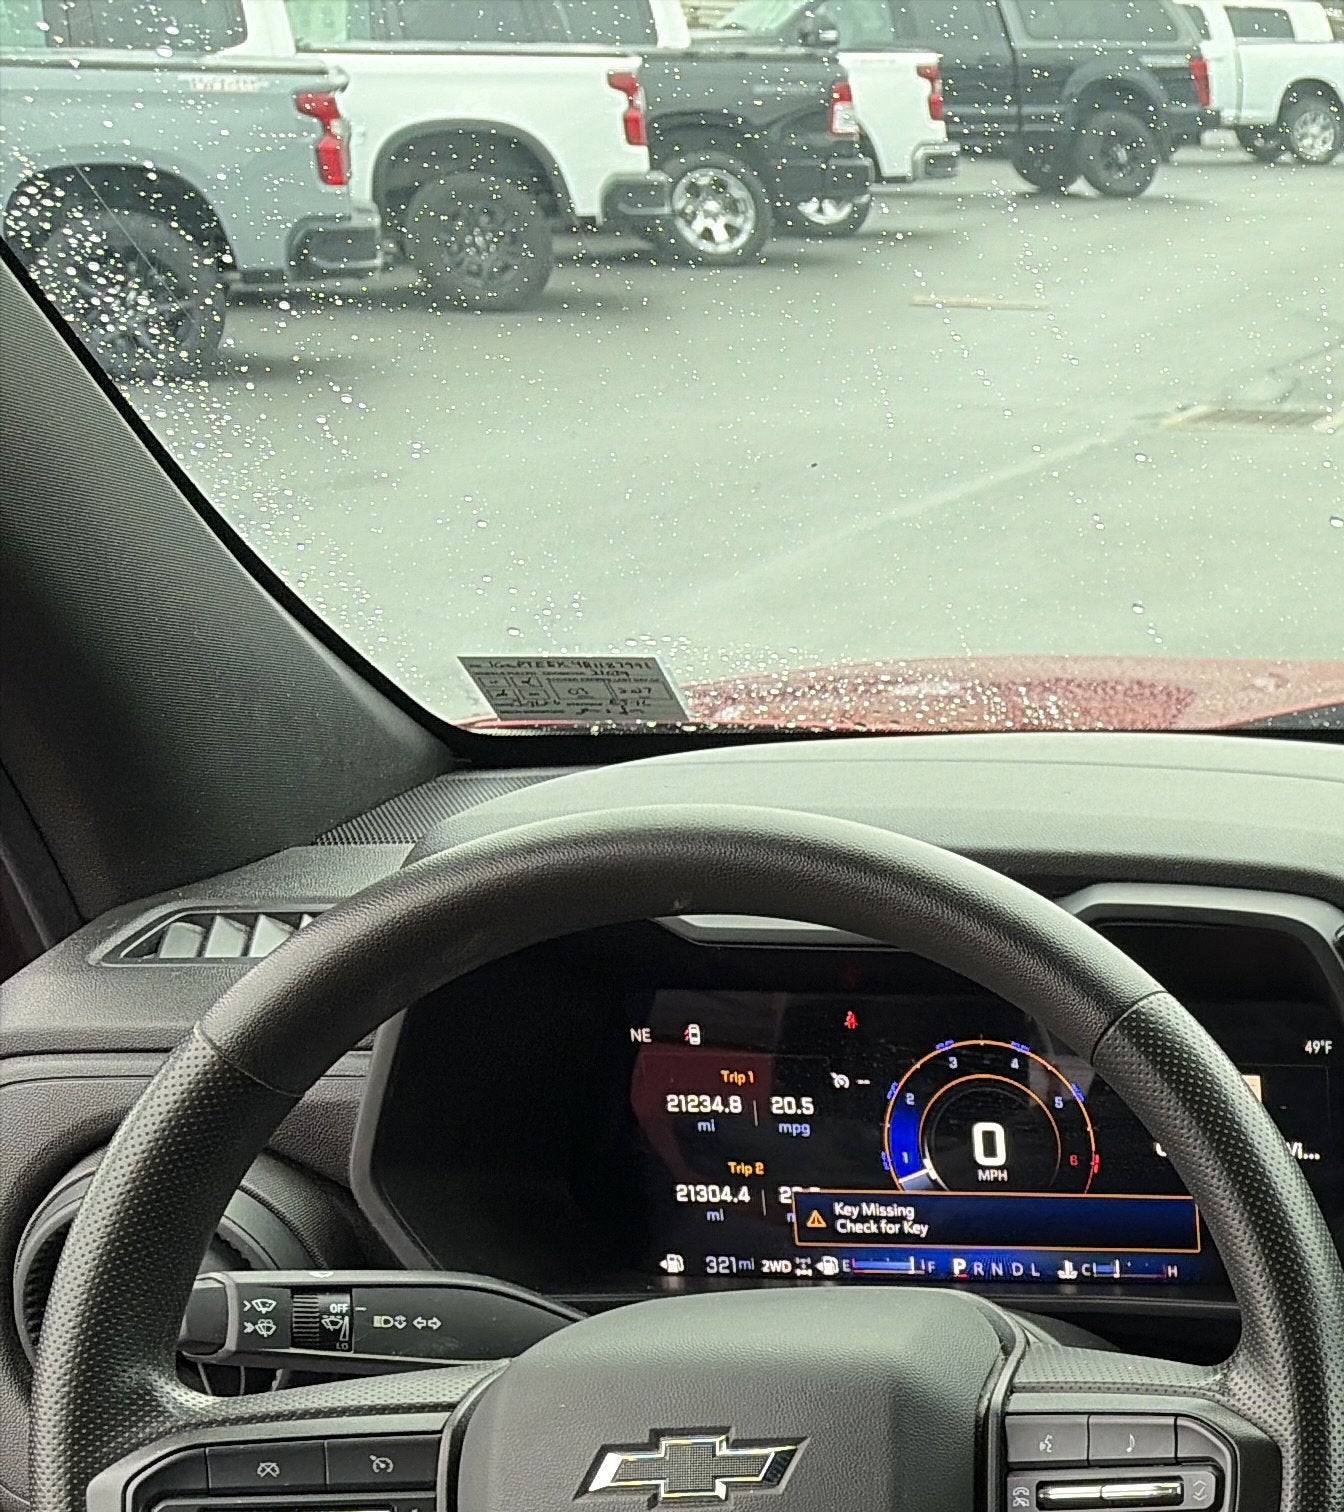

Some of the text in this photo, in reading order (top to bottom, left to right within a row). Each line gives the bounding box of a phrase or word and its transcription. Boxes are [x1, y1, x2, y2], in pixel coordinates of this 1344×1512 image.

[630, 1029, 652, 1043] NE
[1304, 1040, 1333, 1054] 49°F
[949, 1057, 958, 1069] 3
[1011, 1057, 1020, 1069] 4
[721, 1070, 755, 1086] Trip 1
[666, 1095, 743, 1114] 21234.8
[771, 1097, 815, 1115] 20.5
[905, 1092, 915, 1105] 2
[1054, 1096, 1064, 1109] 5
[698, 1119, 716, 1132] mi
[779, 1121, 811, 1137] mpg
[972, 1122, 1006, 1167] 0
[728, 1161, 765, 1177] Trip 2
[978, 1168, 1008, 1181] MPH
[676, 1185, 751, 1203] 21304.4
[707, 1208, 724, 1221] mi
[834, 1203, 915, 1220] Key Missing
[837, 1221, 929, 1238] Check for Key
[706, 1257, 755, 1274] 321 mi
[762, 1259, 792, 1273] 2WD
[953, 1258, 1041, 1277] P R N D L
[329, 1304, 349, 1313] OFF
